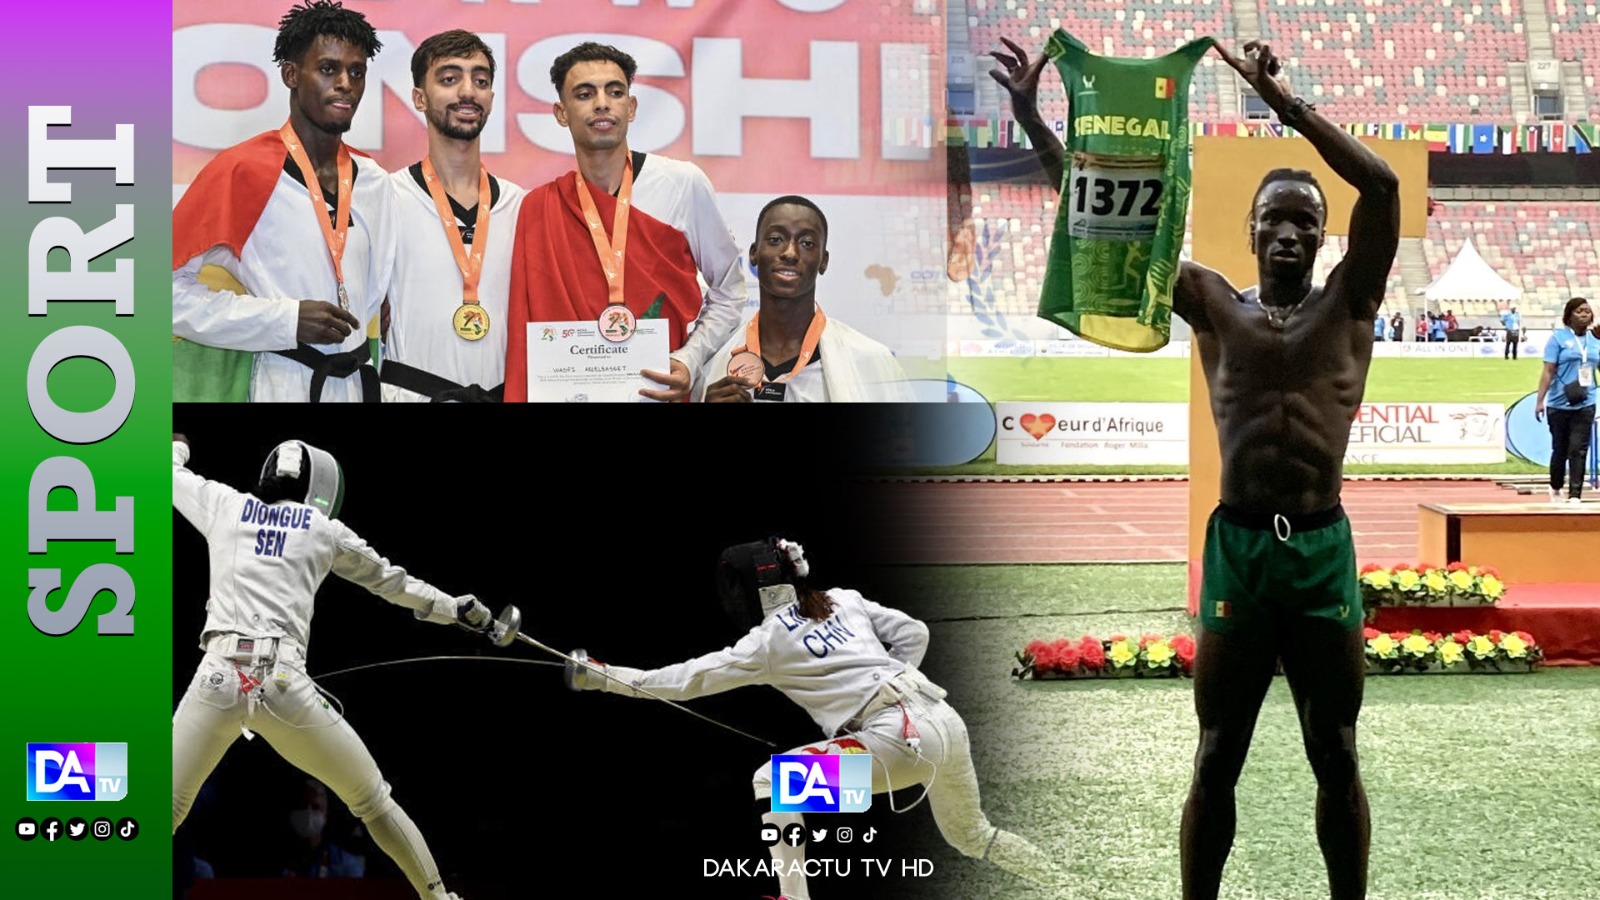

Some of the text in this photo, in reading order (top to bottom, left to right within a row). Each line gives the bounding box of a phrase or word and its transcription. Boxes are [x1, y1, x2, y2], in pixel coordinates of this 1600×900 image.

[1074, 115, 1171, 140] SENEGAL
[1074, 176, 1164, 216] 1372
[570, 344, 629, 355] Certificate
[1061, 441, 1099, 449] Fondation
[1104, 442, 1126, 450] Roger
[241, 499, 313, 530] DIONGUE
[255, 529, 287, 557] SEN
[803, 614, 856, 658] CHN
